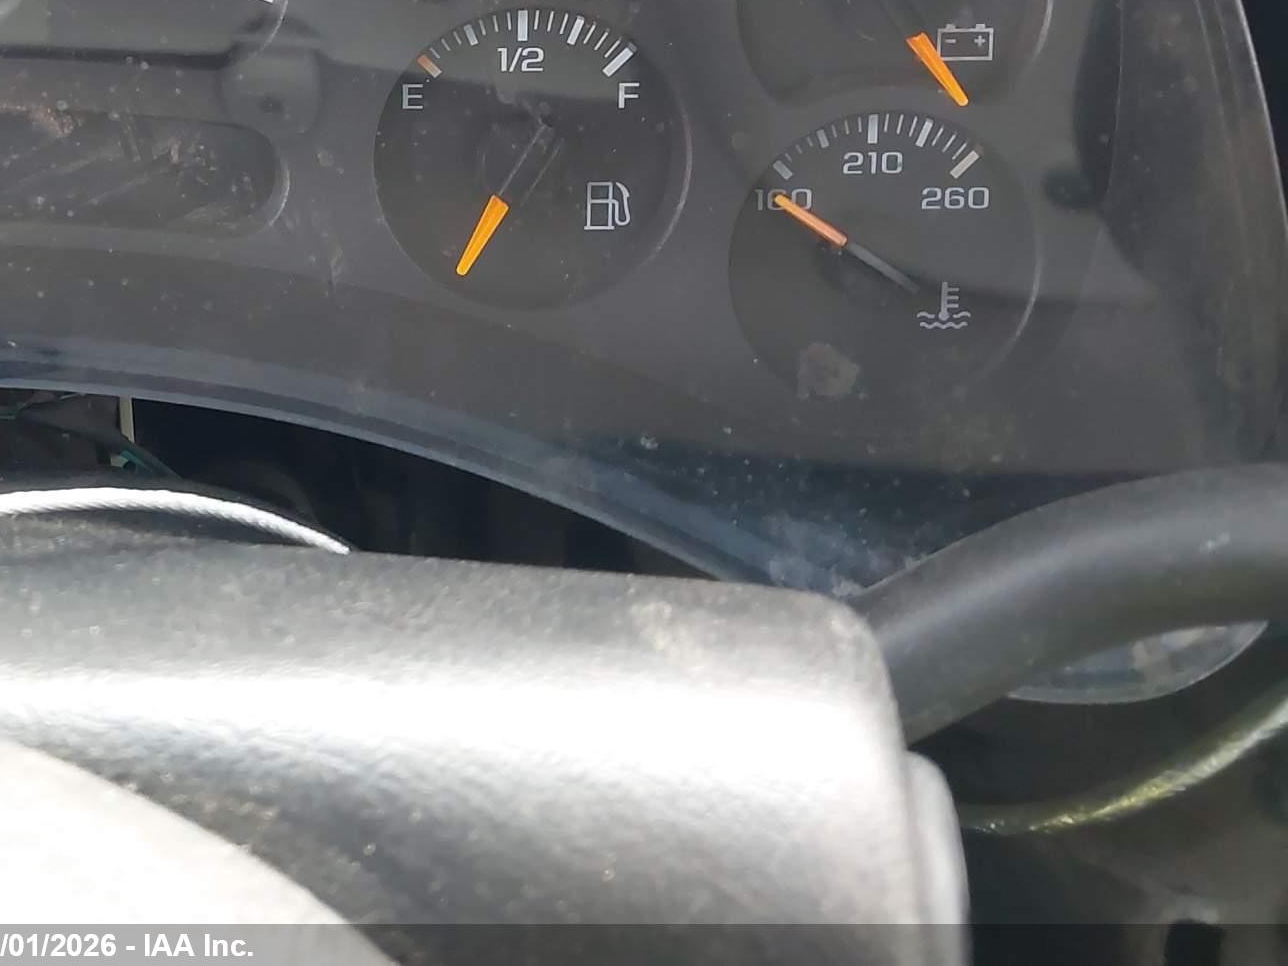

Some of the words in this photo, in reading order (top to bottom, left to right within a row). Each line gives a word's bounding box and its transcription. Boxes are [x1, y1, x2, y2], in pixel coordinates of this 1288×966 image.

[497, 47, 544, 72] 1/2
[402, 83, 424, 110] E
[618, 82, 640, 109] F
[842, 151, 903, 174] 210
[921, 187, 990, 210] 260
